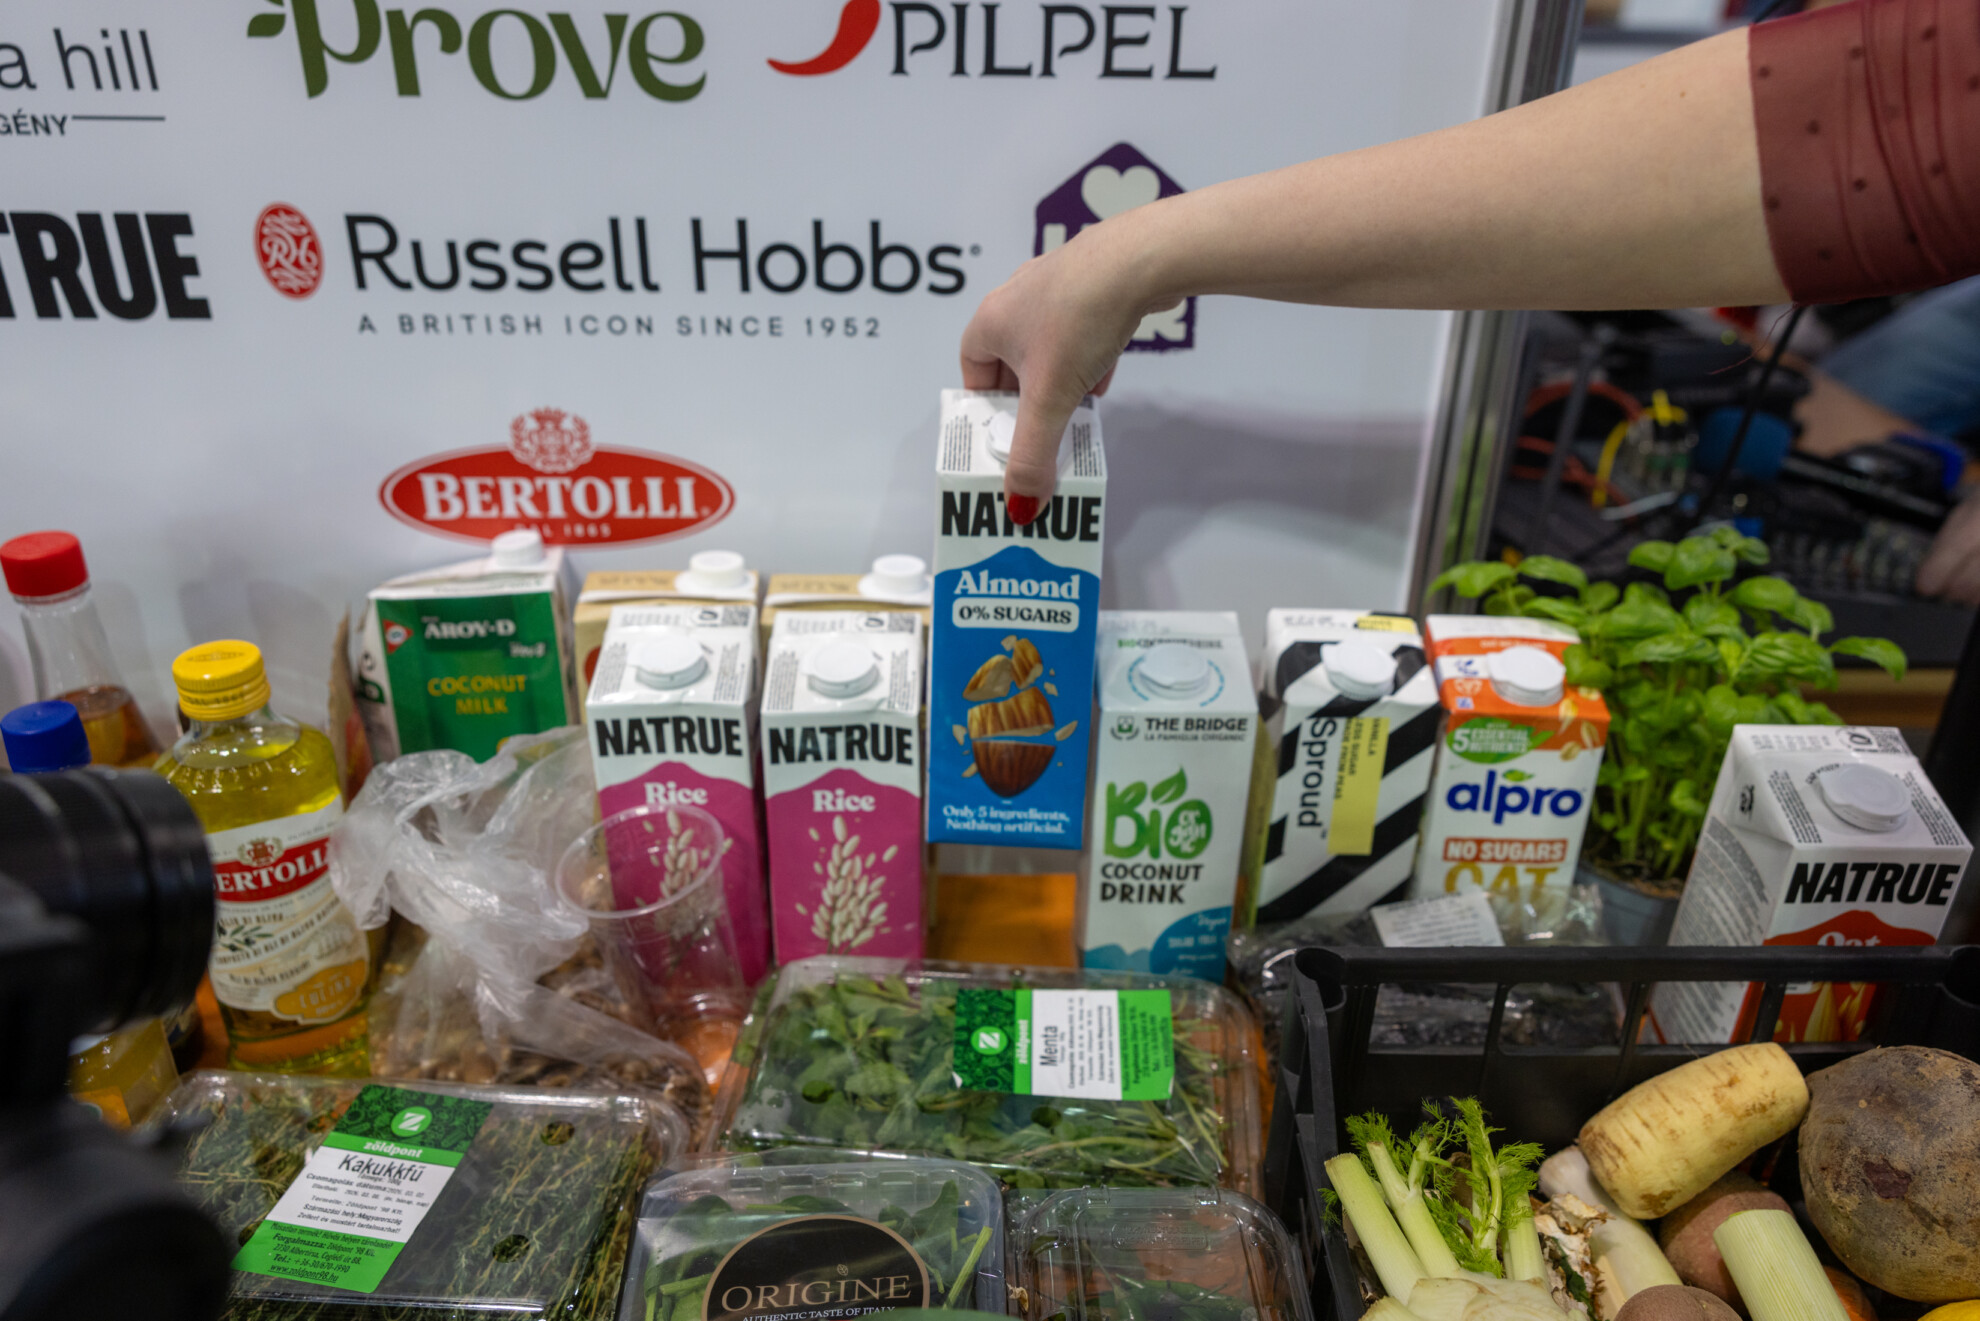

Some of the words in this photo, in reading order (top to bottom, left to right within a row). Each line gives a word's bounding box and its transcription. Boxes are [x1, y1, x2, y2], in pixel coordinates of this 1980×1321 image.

[888, 1, 1218, 80] PILPEL
[53, 28, 159, 91] hill
[0, 211, 212, 321] RUE
[343, 213, 661, 292] Russell
[690, 217, 967, 294] Hobbs
[358, 314, 377, 335] A
[399, 313, 543, 335] BRITISH
[564, 314, 654, 336] ICON
[677, 315, 784, 337] SINCE
[804, 315, 881, 338] 1952
[418, 472, 700, 521] BERTOLLI
[953, 569, 1081, 600] Almond
[959, 605, 990, 621] 0%
[993, 606, 1073, 625] SUGARS
[427, 674, 527, 697] COCONUT
[456, 696, 508, 715] MILK
[594, 716, 743, 758] NATRUE
[1144, 717, 1180, 731] THE
[1184, 717, 1248, 732] BRIDGE
[768, 723, 914, 766] NATRUE
[1452, 728, 1471, 752] 5
[1297, 717, 1338, 828] Sproud
[644, 781, 708, 806] Rice
[812, 788, 875, 813] Rice
[1446, 769, 1584, 825] alpro
[942, 805, 974, 819] Only
[978, 806, 987, 817] 5
[945, 819, 1001, 833] Nothing
[1449, 839, 1478, 859] NO
[1479, 840, 1564, 861] SUGARS
[213, 848, 327, 892] ERTOLL
[1100, 863, 1204, 881] COCONUT
[1100, 882, 1186, 904] DRINK
[1784, 862, 1960, 906] NATRUE
[1039, 1025, 1059, 1068] Menta
[363, 1140, 423, 1159] zöldpont
[720, 1274, 912, 1312] ORIGINE
[808, 1308, 844, 1319] TASTE
[845, 1307, 861, 1316] OF
